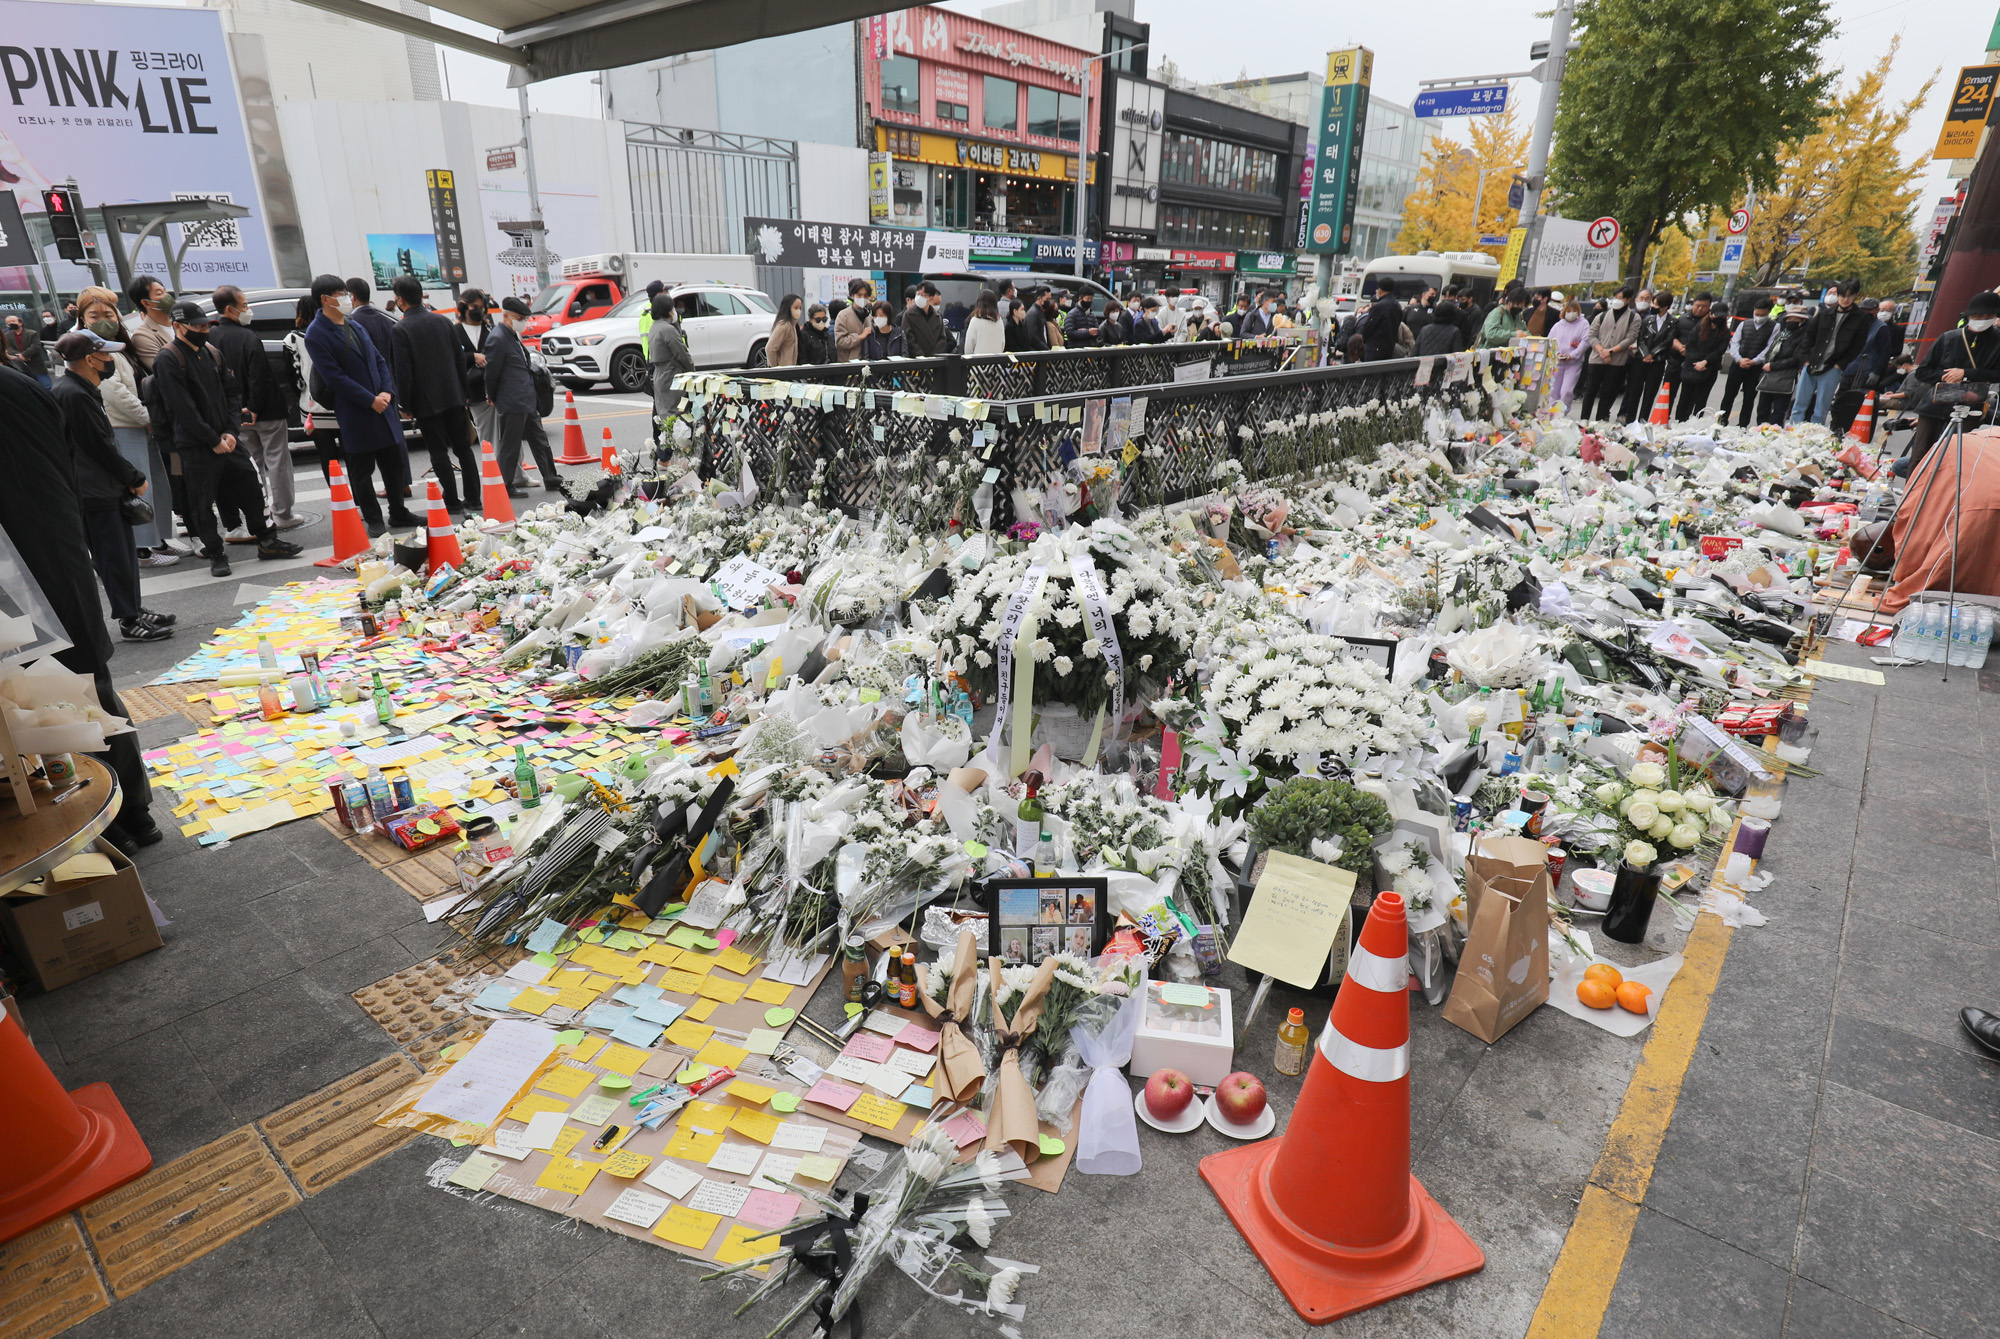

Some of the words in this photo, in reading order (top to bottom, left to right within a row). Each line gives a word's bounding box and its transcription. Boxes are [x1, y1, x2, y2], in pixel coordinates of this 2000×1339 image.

[130, 50, 204, 72] 핑크라이
[0, 45, 130, 111] PINK
[1964, 75, 1993, 85] emart
[1471, 89, 1504, 102] 보광로
[1957, 84, 1989, 104] 24
[135, 77, 218, 134] LIE
[18, 116, 55, 126] 디즈니+
[97, 118, 134, 127] 리얼리티
[1322, 120, 1341, 184] 이태원
[1943, 138, 1974, 146] 아이디어
[969, 143, 1003, 166] 이바돔
[1008, 149, 1041, 171] 감자탕
[444, 190, 451, 200] 4
[445, 208, 457, 244] 이태원
[1297, 201, 1310, 248] ALPEDO
[1315, 228, 1330, 238] 630
[794, 223, 833, 245] 이태원
[839, 226, 864, 247] 참사
[869, 229, 915, 250] 희생자의
[997, 236, 1022, 249] KEBAB
[817, 247, 855, 267] 명복을
[861, 249, 896, 268] 빕니다
[938, 248, 965, 260] 국민의힘
[1037, 244, 1063, 259] EDIYA
[1065, 246, 1096, 260] COFEE
[1258, 254, 1284, 265] ALPEDO
[204, 262, 249, 274] 공개된다!
[1091, 606, 1108, 632] 너의
[999, 645, 1011, 666] 나의
